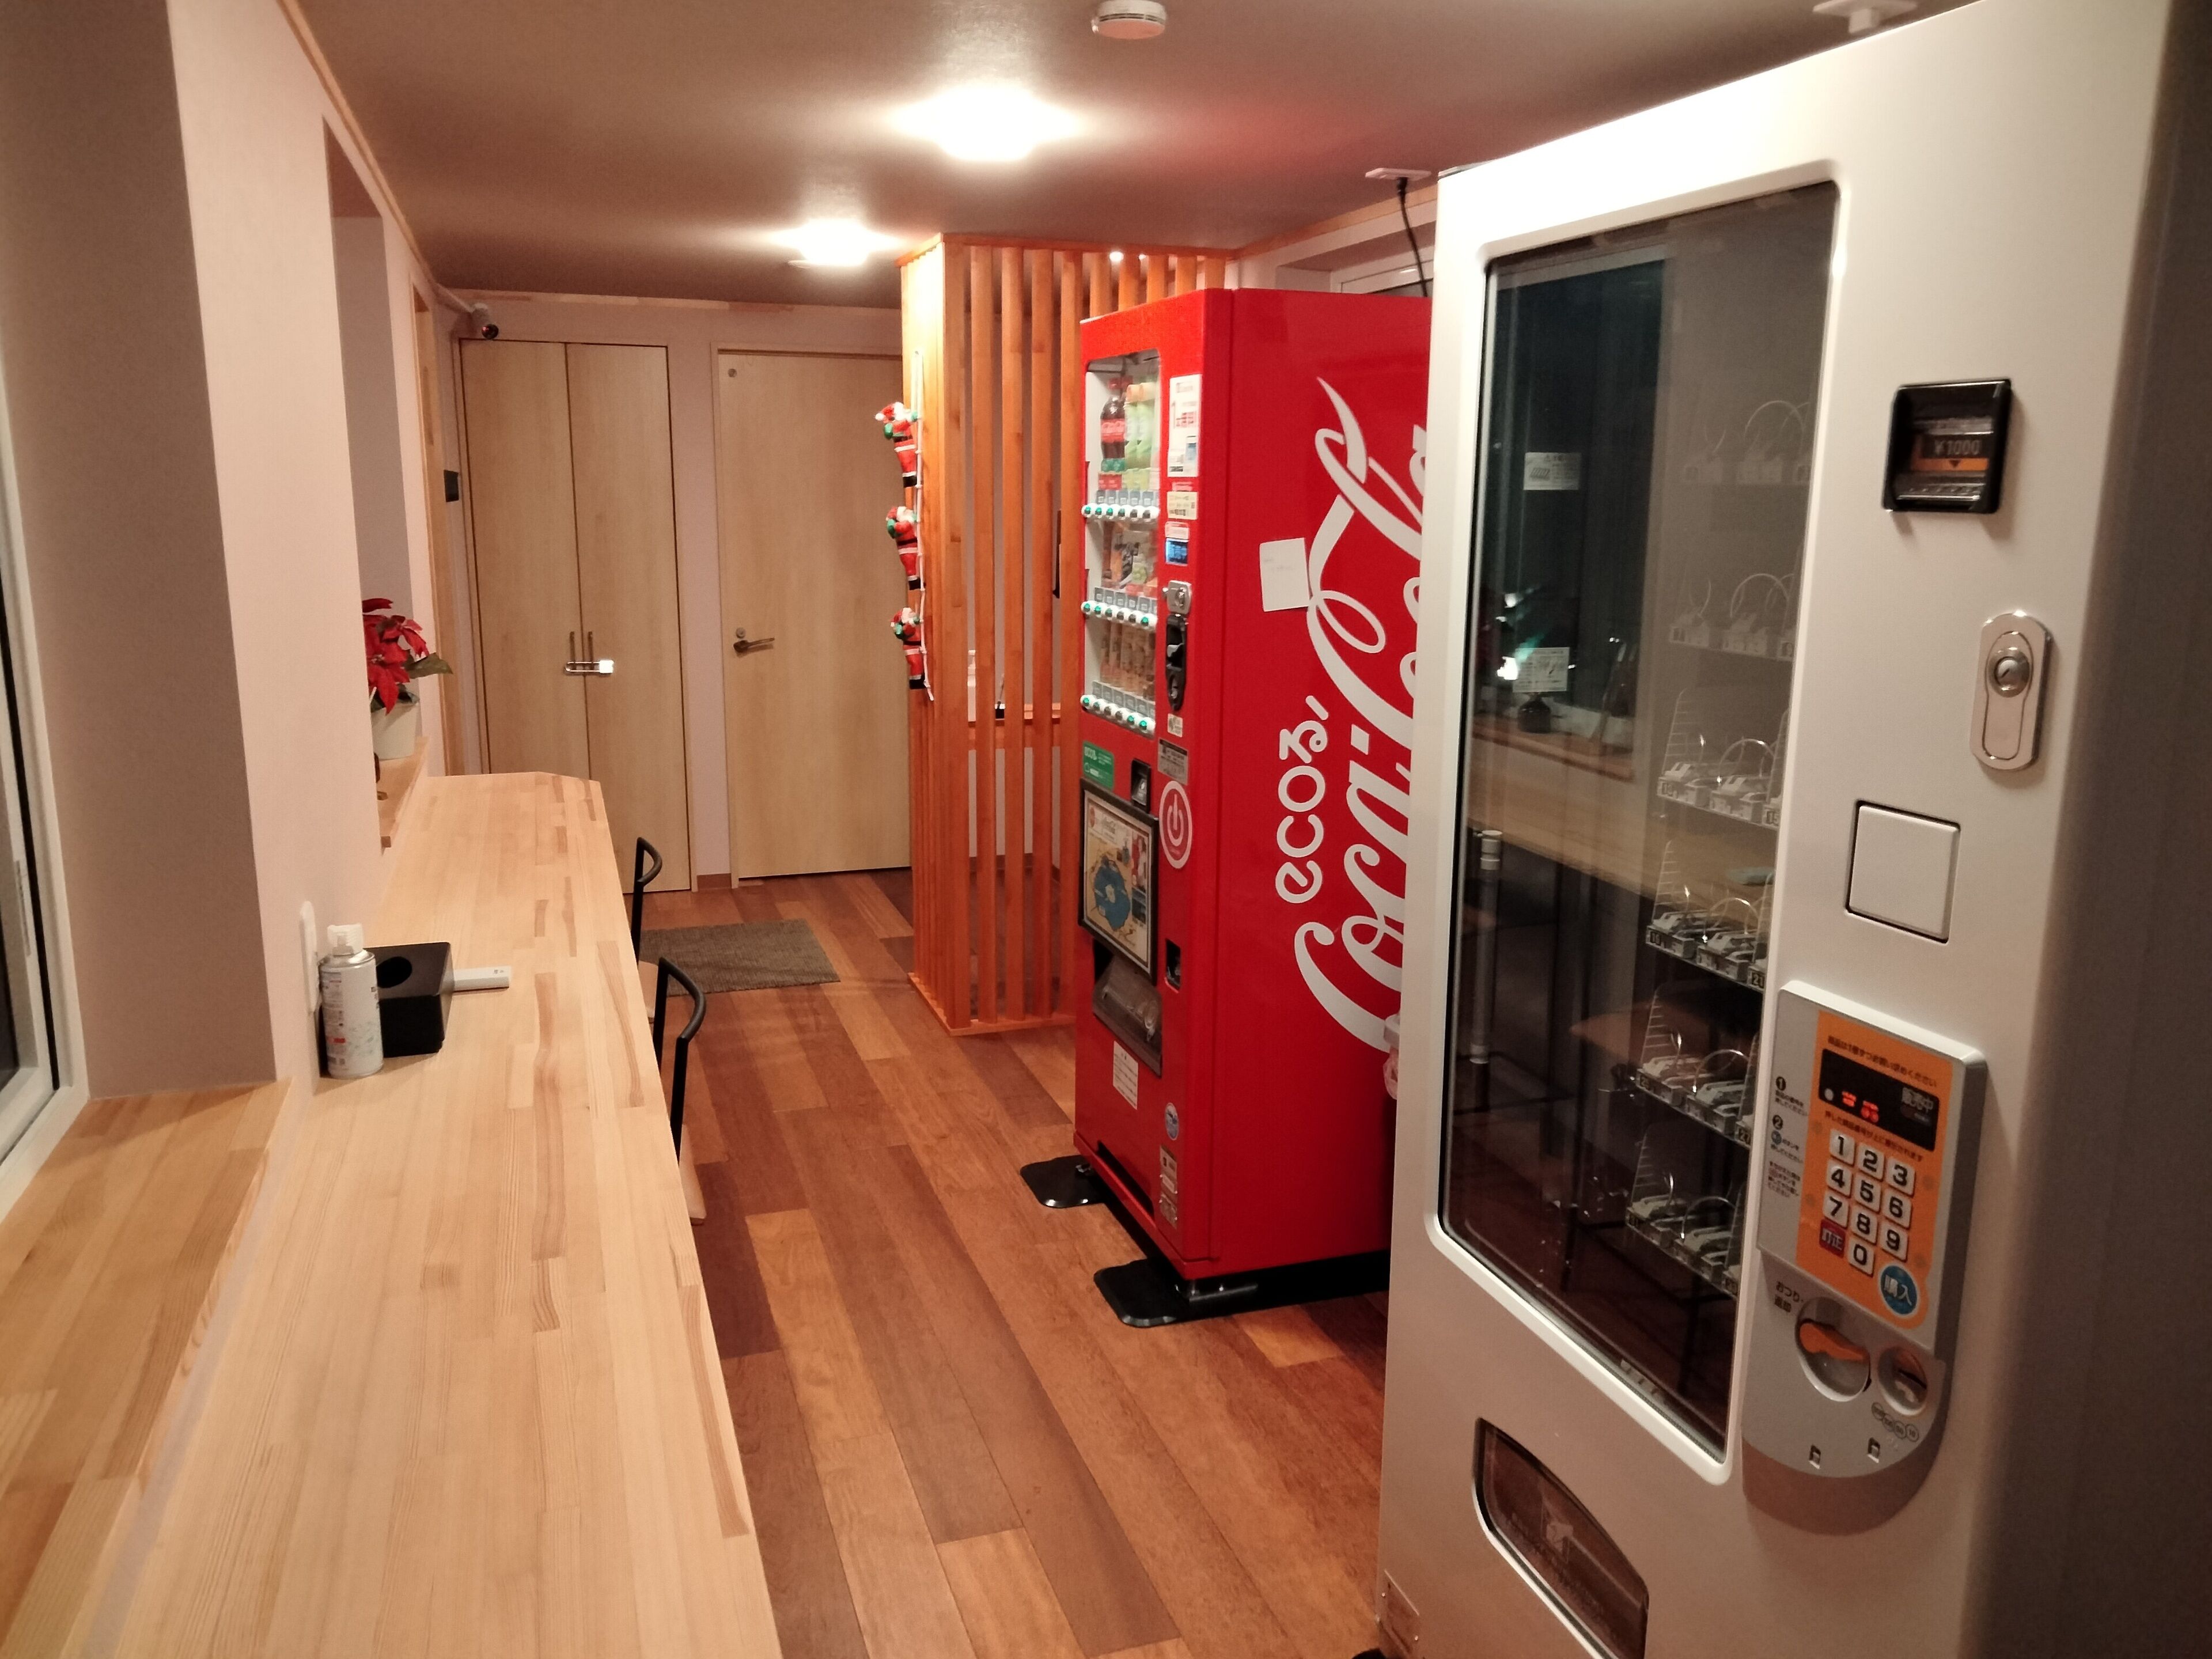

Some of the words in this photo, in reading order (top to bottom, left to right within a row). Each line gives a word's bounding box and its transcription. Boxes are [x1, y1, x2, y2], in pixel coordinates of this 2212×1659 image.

[1294, 376, 1427, 1054] Coca-Cl
[1838, 1135, 1844, 1156] 1
[1863, 1150, 1878, 1173] 2
[1892, 1164, 1908, 1187] 3
[1831, 1169, 1846, 1188] 4
[1859, 1181, 1874, 1203] 5
[1889, 1196, 1903, 1219] 6
[1821, 1227, 1843, 1251] 訂正
[1830, 1196, 1843, 1217] 7
[1857, 1213, 1871, 1235] 8
[1886, 1229, 1900, 1252] 9
[1853, 1244, 1868, 1266] 0
[1884, 1274, 1912, 1306] 購入
